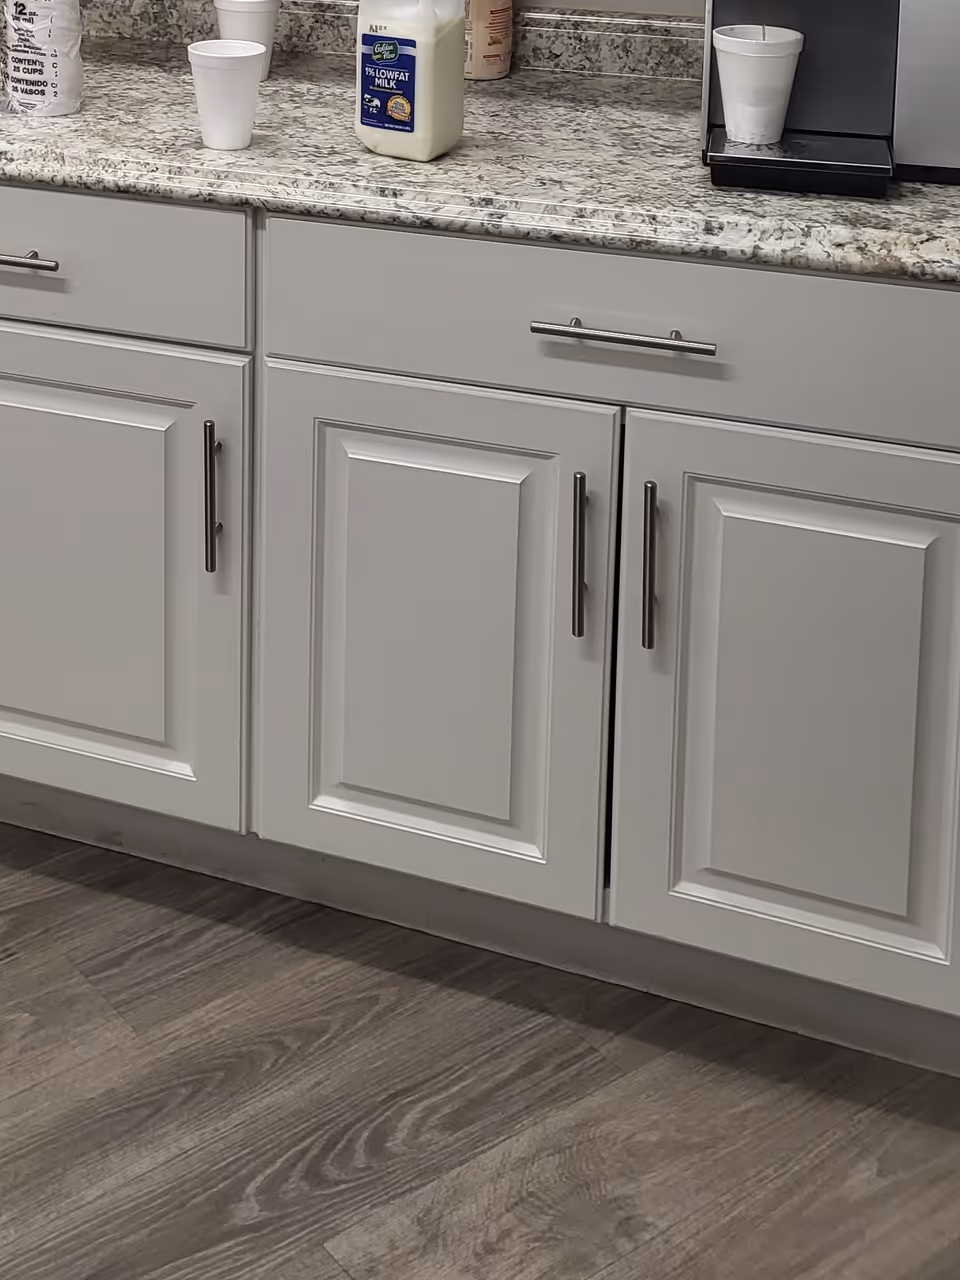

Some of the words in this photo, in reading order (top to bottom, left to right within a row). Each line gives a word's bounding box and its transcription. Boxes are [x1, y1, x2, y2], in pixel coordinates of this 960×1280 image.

[13, 1, 27, 16] 12
[11, 56, 45, 68] CONTENTS
[13, 65, 21, 73] 25
[22, 67, 44, 76] CUPS
[365, 66, 375, 77] 1%
[375, 69, 410, 82] LOWFAT
[11, 76, 48, 88] CONTENIDO
[374, 77, 397, 89] MILK
[12, 85, 19, 93] 25
[20, 87, 46, 97] VASOS
